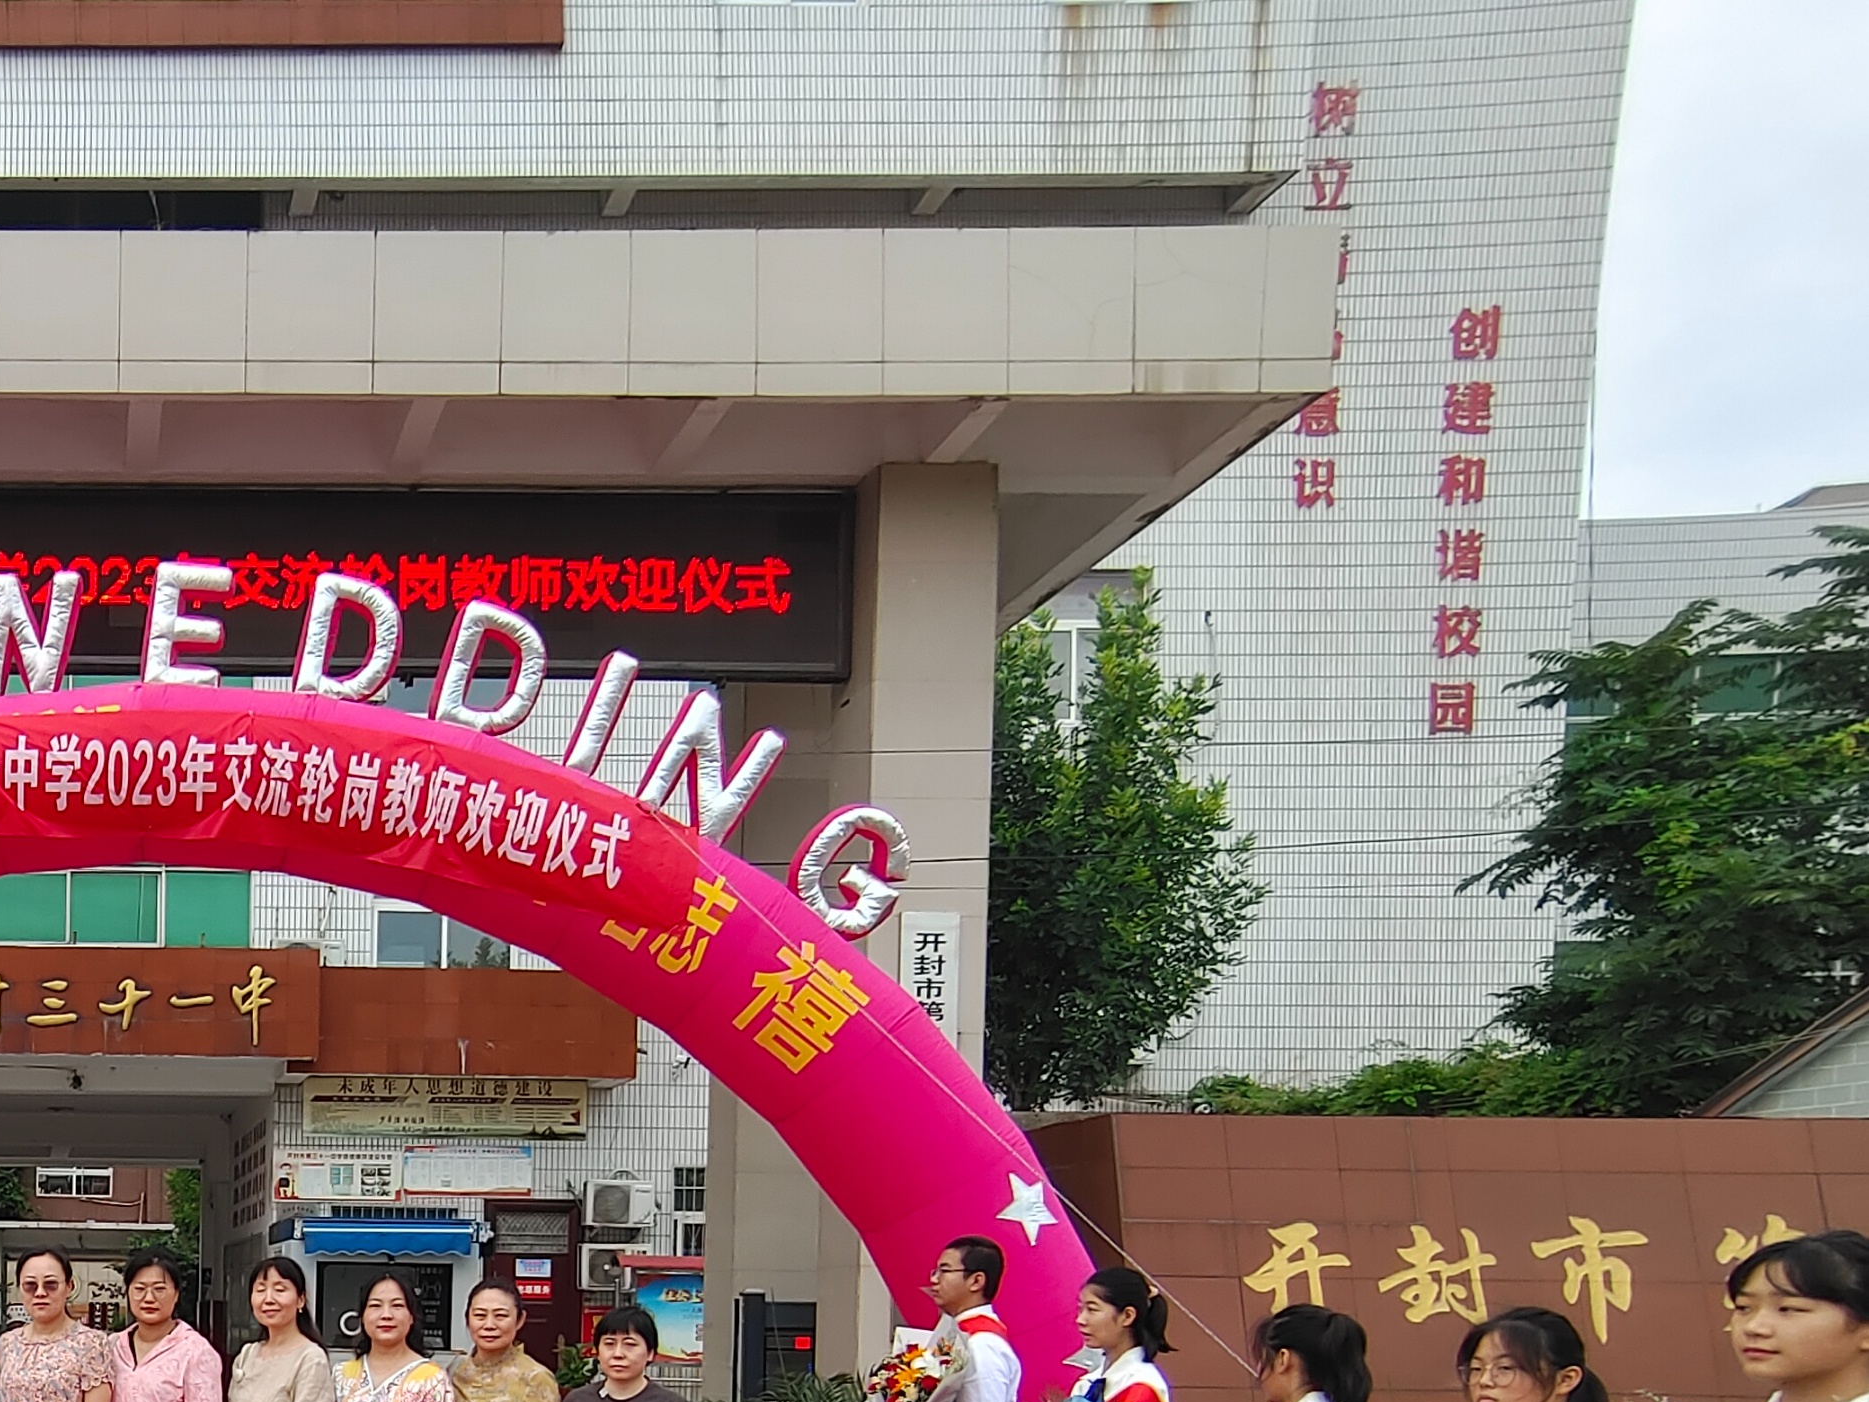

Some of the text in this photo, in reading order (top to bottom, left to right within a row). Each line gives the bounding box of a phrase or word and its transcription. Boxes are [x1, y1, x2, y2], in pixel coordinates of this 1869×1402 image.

[1293, 79, 1360, 509] 树立意识
[1428, 304, 1501, 736] 创建和谐校园
[337, 1078, 554, 1096] 未成年人思想道德建设
